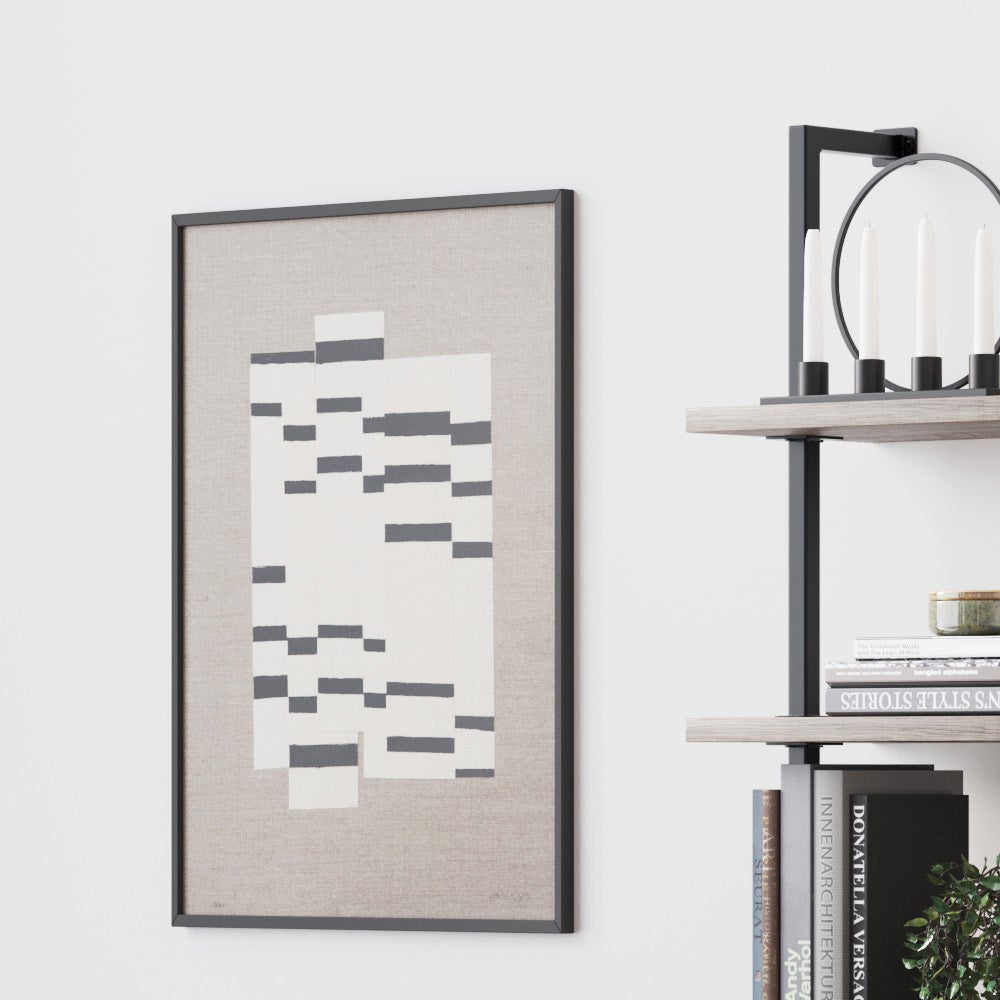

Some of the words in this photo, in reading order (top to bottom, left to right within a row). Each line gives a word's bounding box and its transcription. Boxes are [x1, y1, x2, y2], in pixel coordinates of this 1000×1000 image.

[840, 691, 913, 710] STORIES
[916, 691, 971, 709] STYLE
[853, 804, 865, 926] DONATELLA
[754, 858, 762, 943] SEURAT
